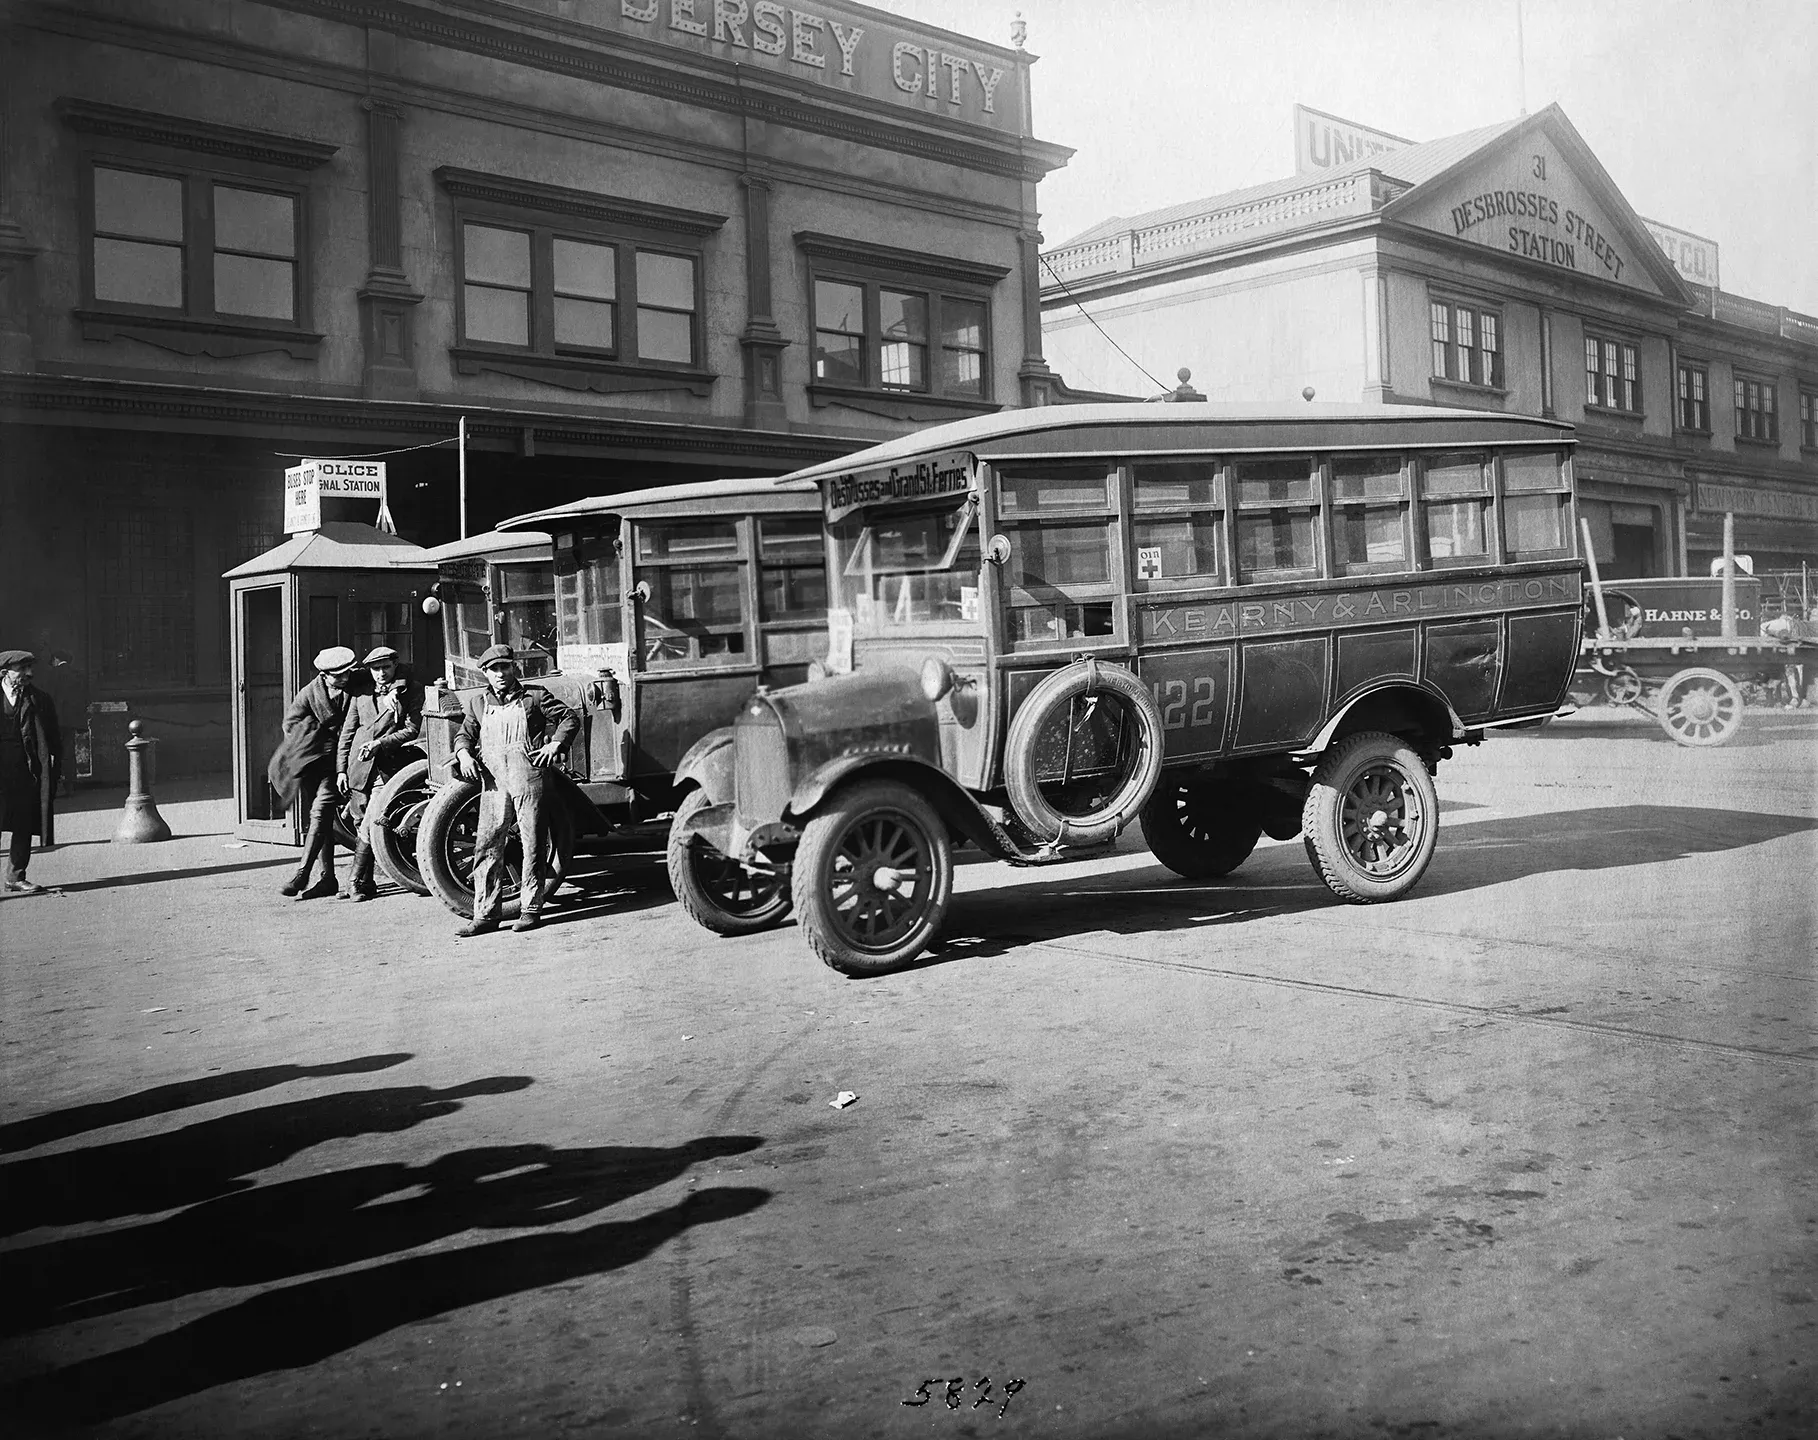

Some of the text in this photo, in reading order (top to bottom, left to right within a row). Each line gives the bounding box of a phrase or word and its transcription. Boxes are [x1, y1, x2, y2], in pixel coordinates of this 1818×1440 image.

[892, 40, 1004, 114] CITY
[1532, 154, 1547, 181] 31
[1451, 190, 1624, 280] DESBROSSES STREET
[1508, 227, 1576, 268] STATION
[287, 468, 315, 489] BUSES STOP
[343, 478, 380, 492] STATION
[891, 465, 920, 498] Grand
[932, 462, 968, 494] Ferries
[1151, 578, 1570, 636] KEARNY & ARLINGTON
[1644, 608, 1707, 622] HAHNE
